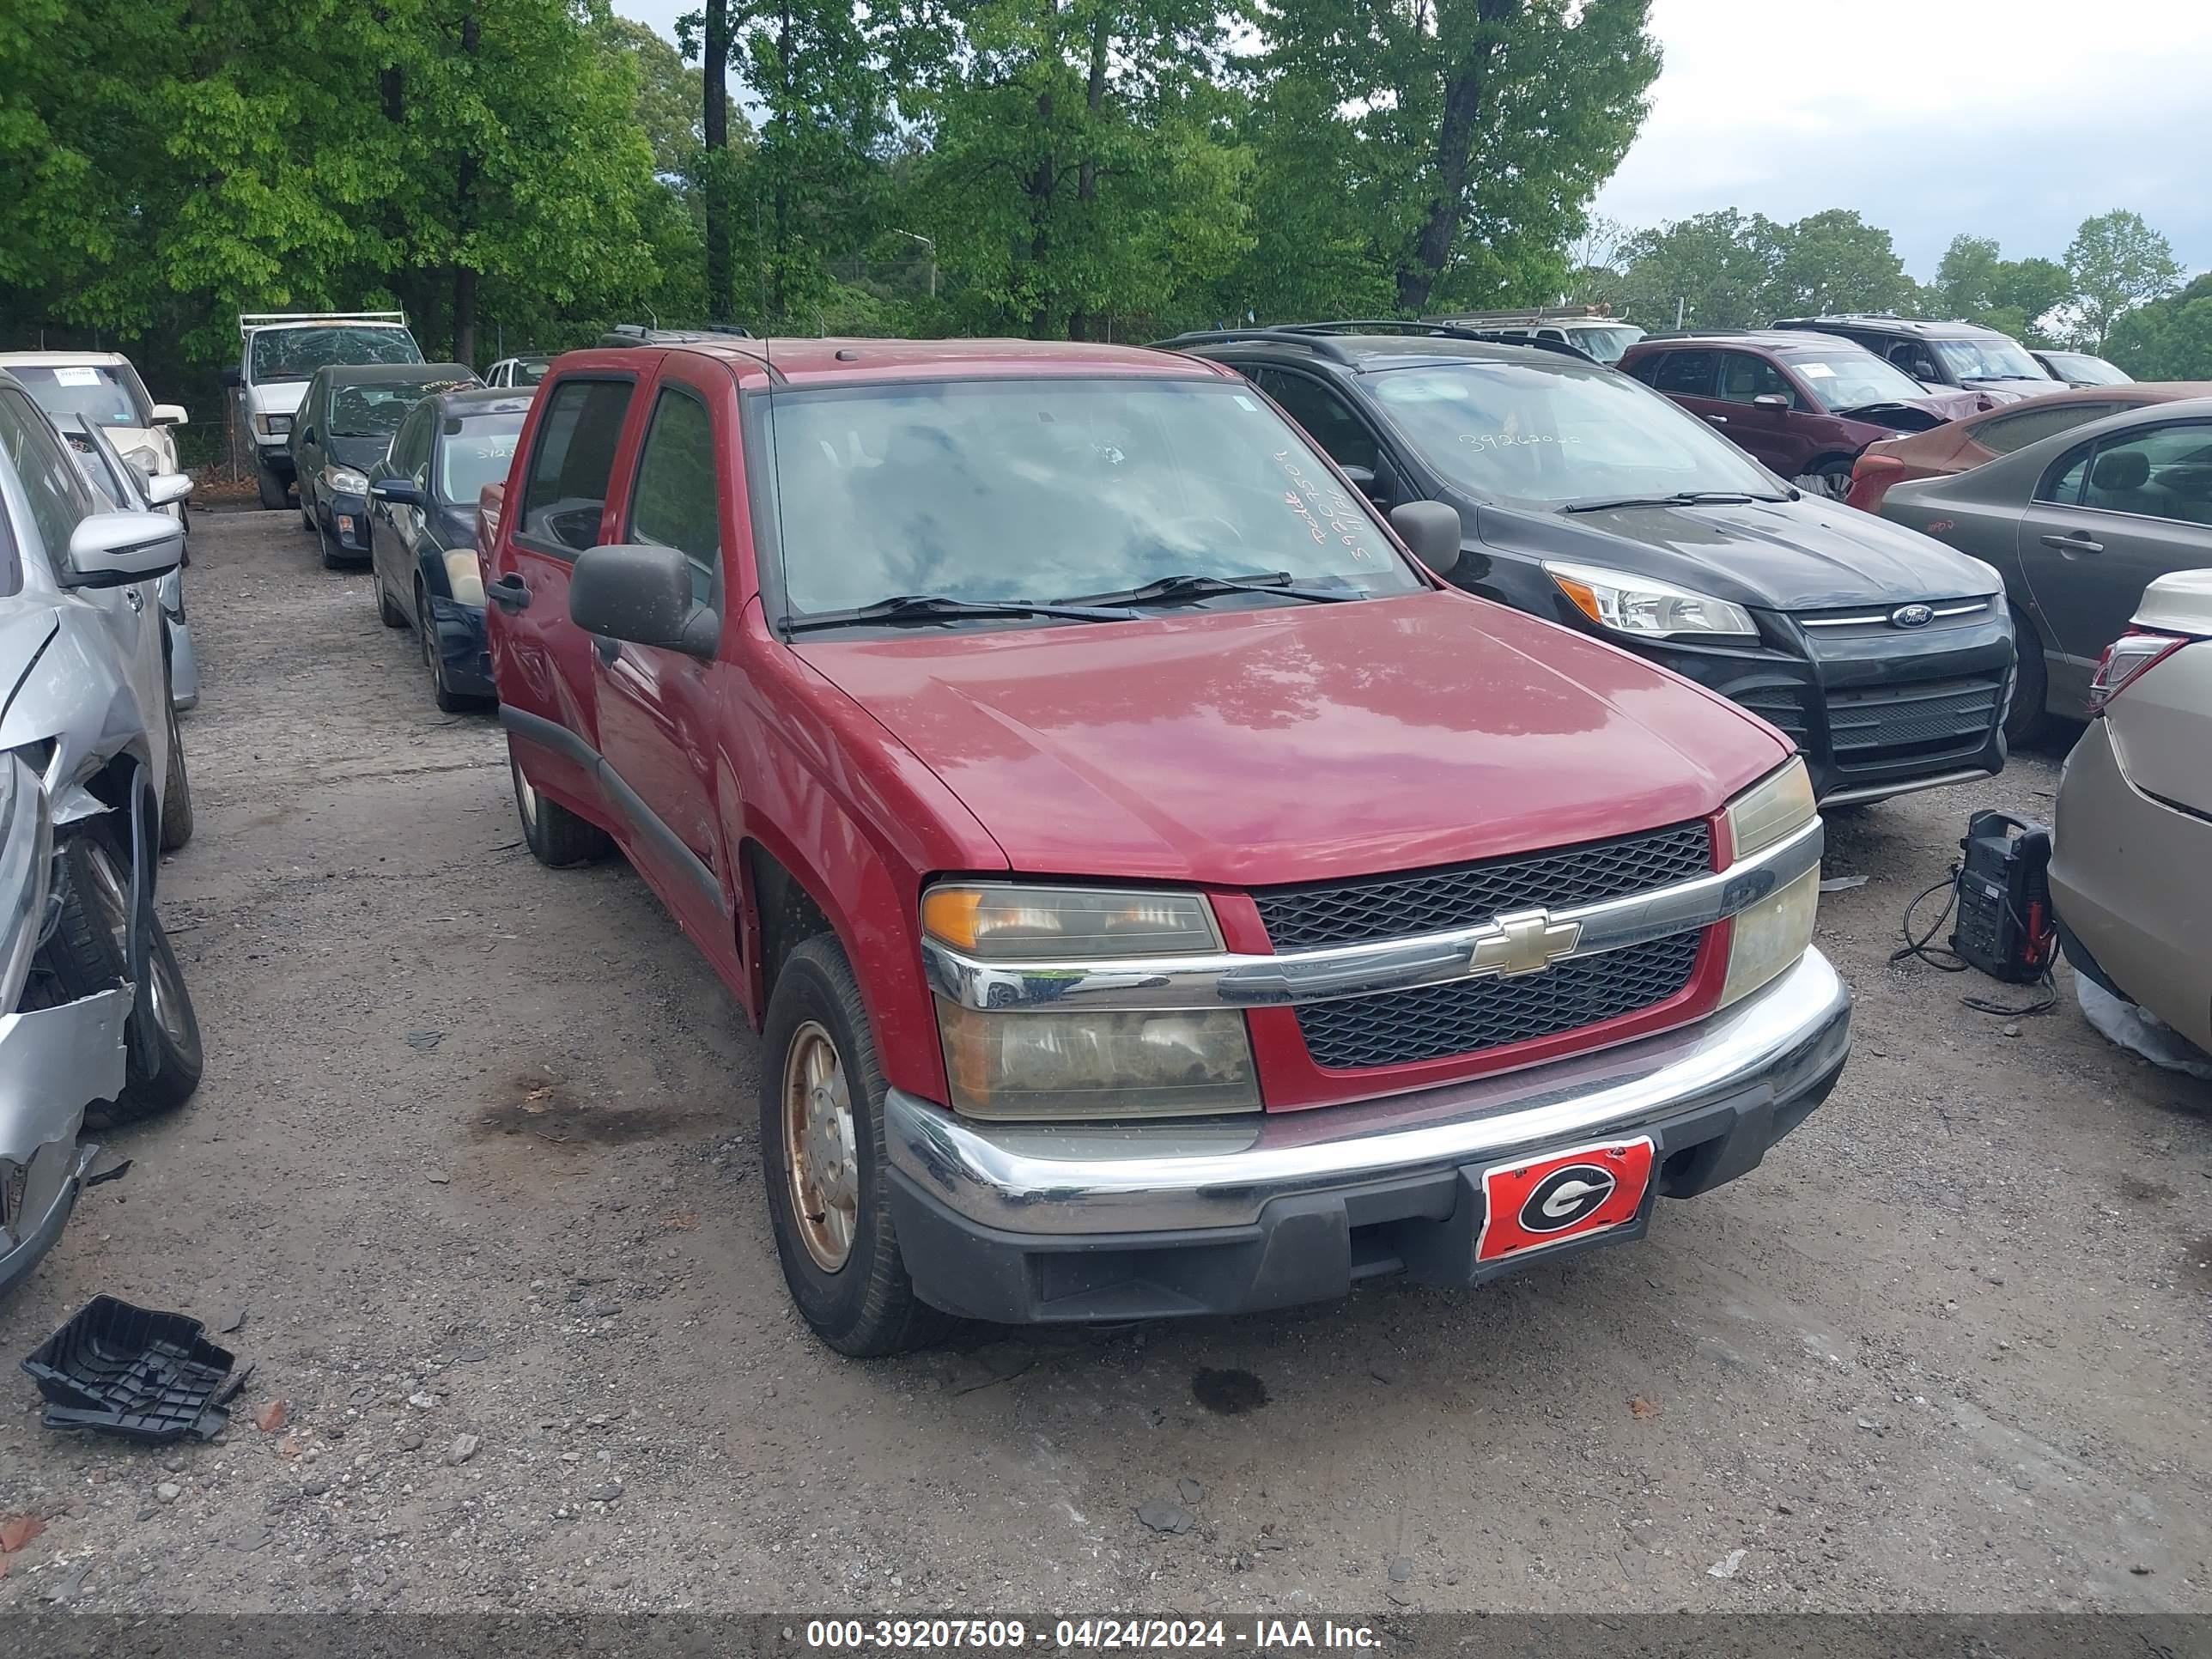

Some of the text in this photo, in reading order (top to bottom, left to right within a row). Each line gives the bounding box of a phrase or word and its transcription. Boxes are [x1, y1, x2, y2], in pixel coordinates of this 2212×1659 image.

[1273, 451, 1371, 561] 39207509
[1327, 489, 1364, 533] 4/24
[1905, 608, 1928, 623] Ford
[1518, 1164, 1616, 1233] G
